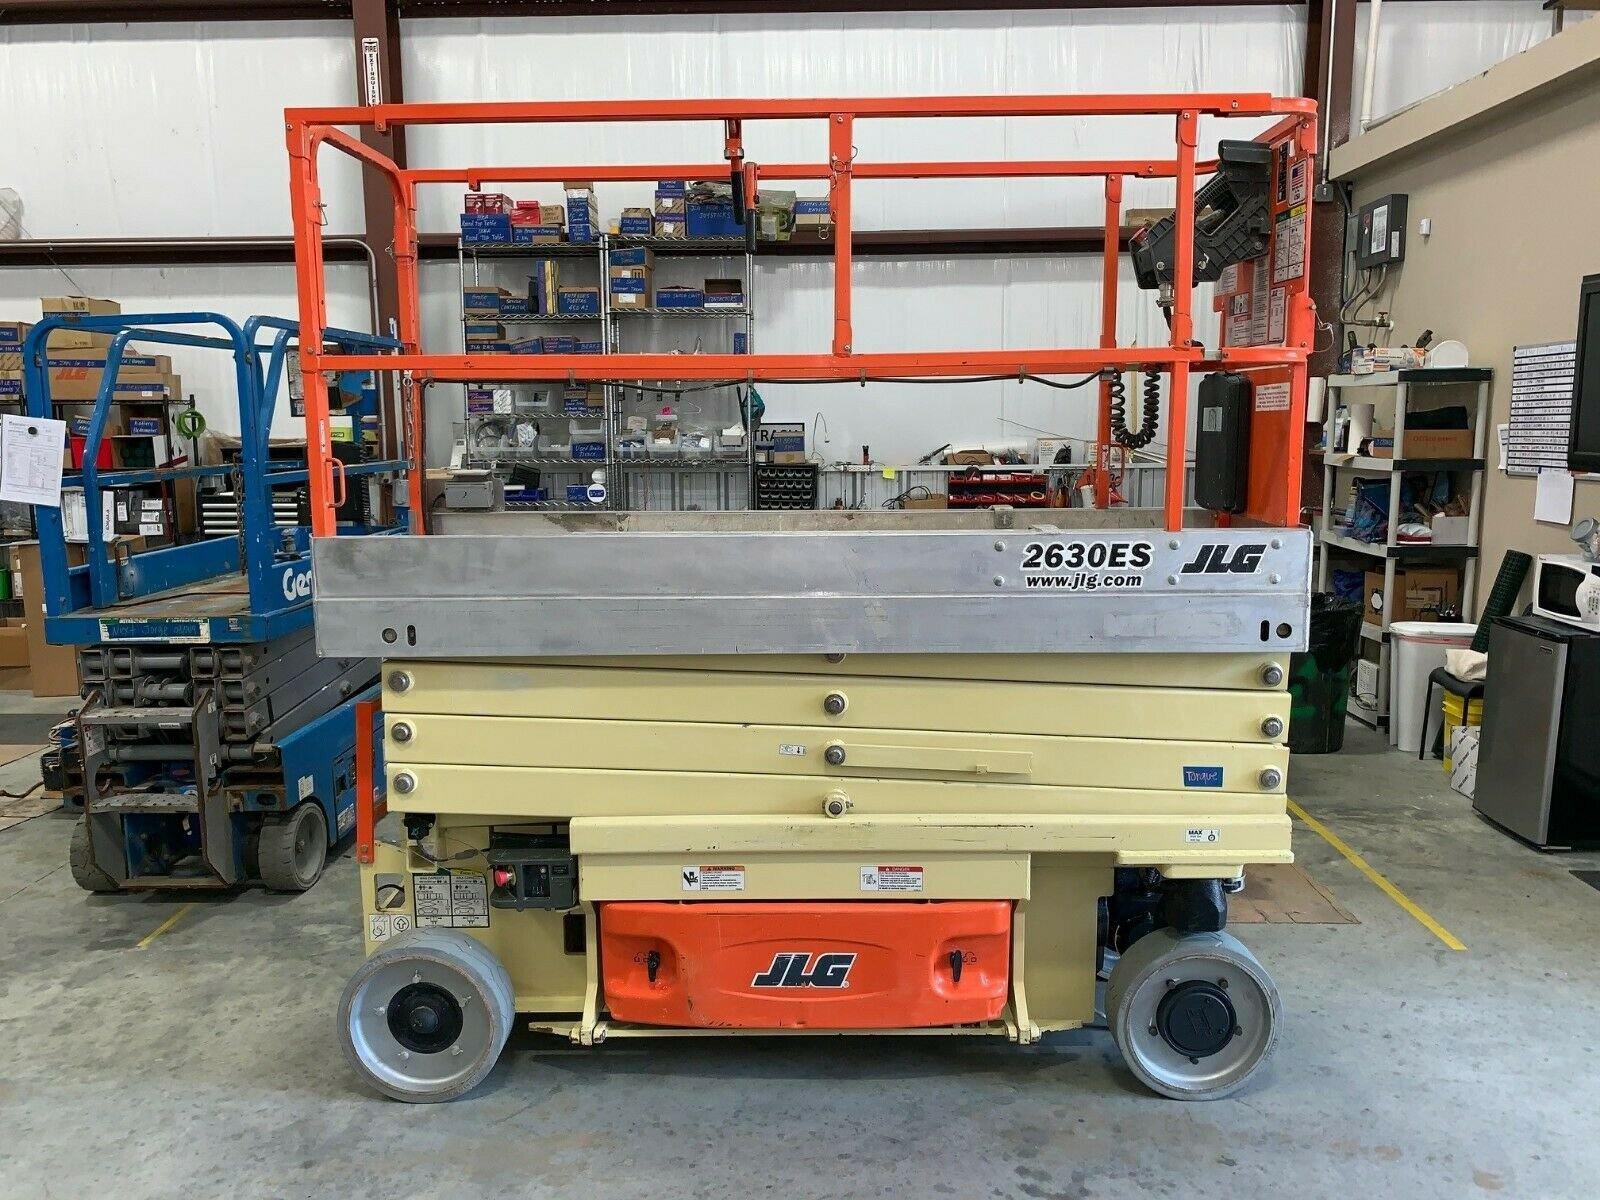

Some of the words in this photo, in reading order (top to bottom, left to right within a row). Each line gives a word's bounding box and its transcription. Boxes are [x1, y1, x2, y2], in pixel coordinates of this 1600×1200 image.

[56, 367, 88, 380] JLG
[1022, 543, 1152, 568] 2630ES
[1181, 544, 1268, 573] JLG
[1026, 574, 1142, 589] www.jlg.com
[1186, 771, 1218, 785] Torque
[751, 952, 858, 988] JLG
